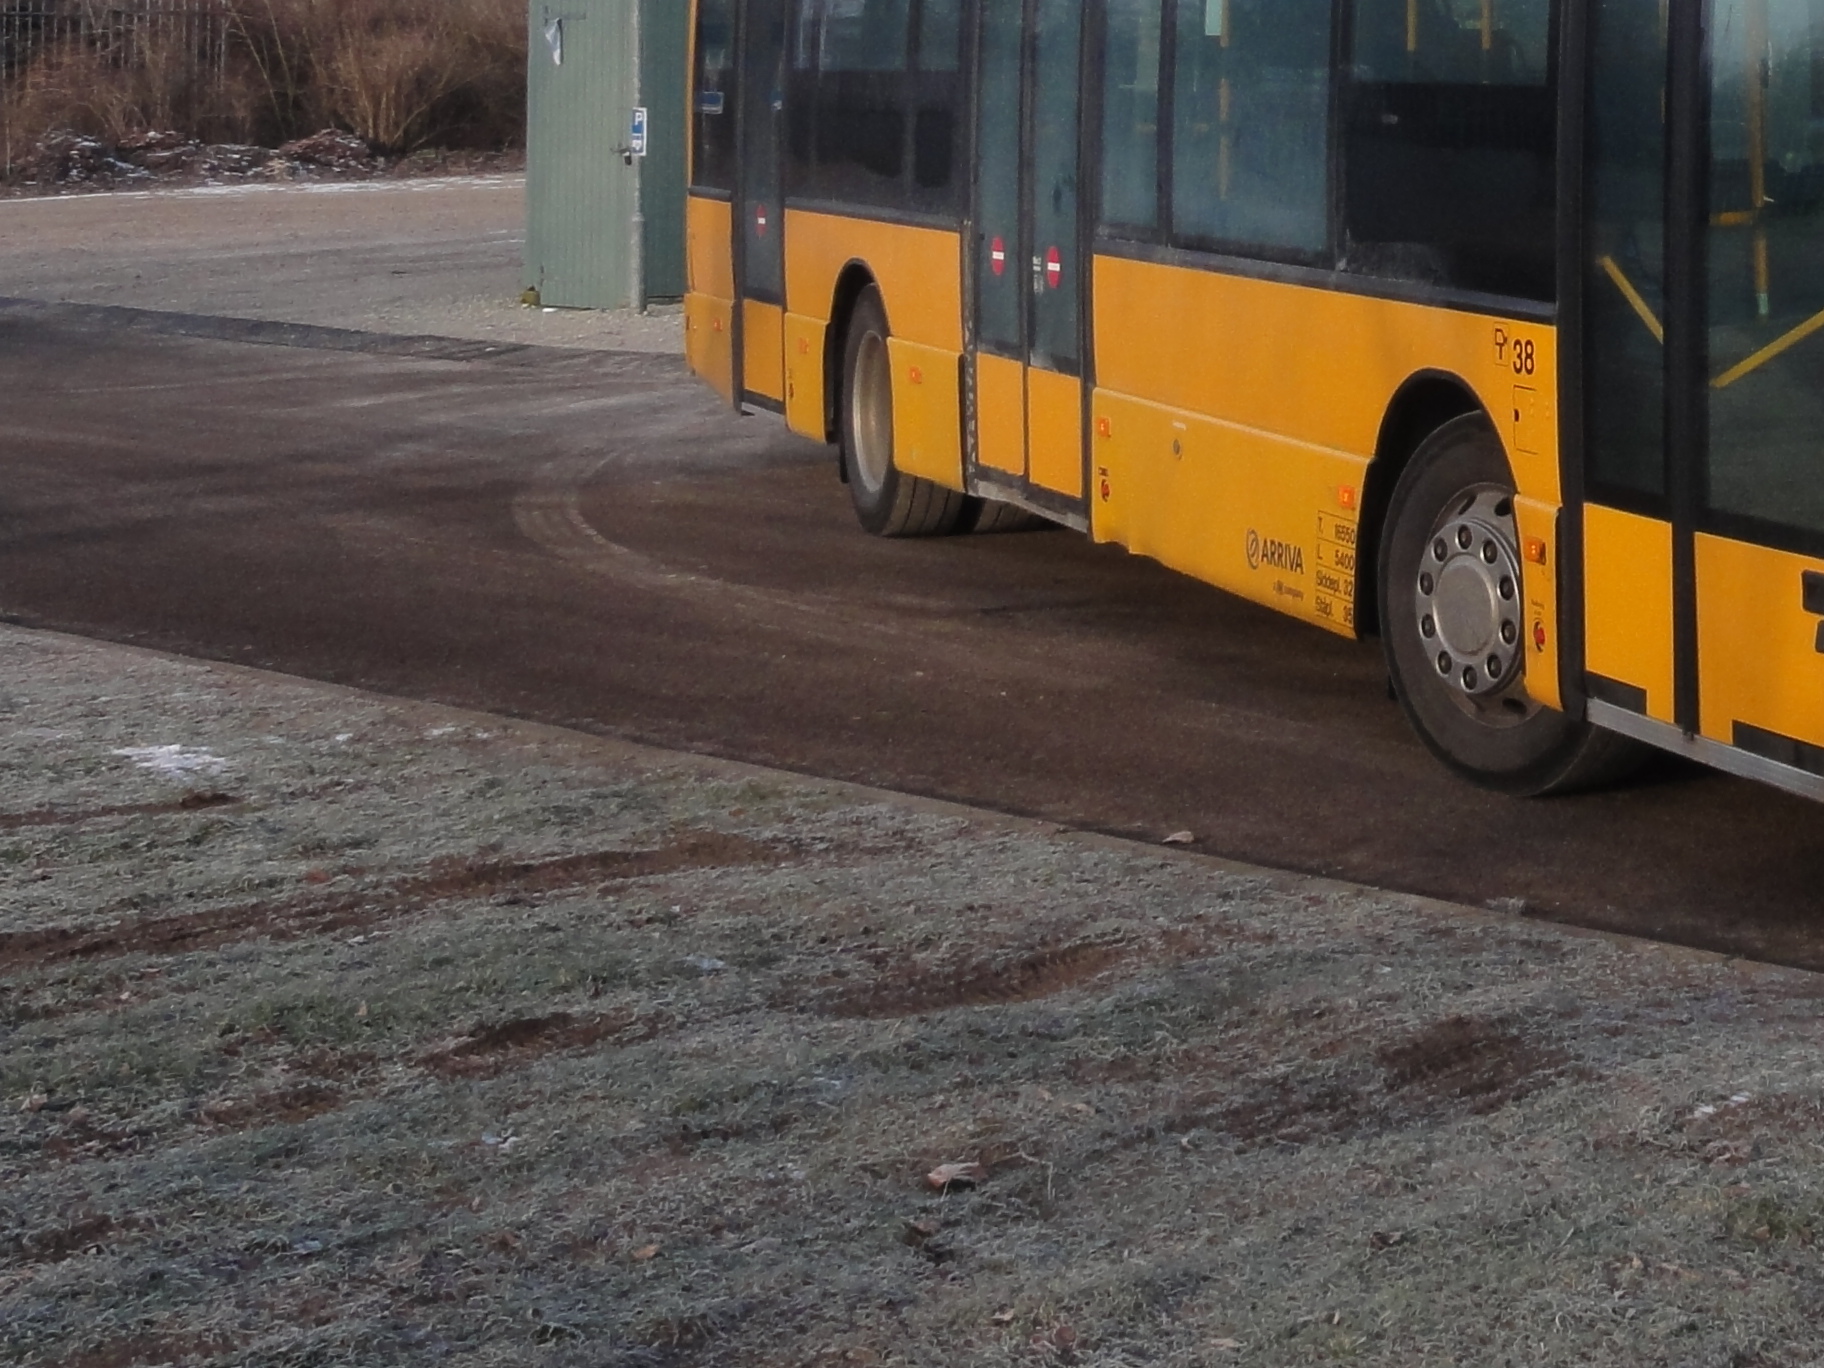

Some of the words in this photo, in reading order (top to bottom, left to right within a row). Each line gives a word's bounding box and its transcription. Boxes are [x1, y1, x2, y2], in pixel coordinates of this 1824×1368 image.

[635, 112, 643, 125] P
[1513, 339, 1535, 375] 38
[1261, 537, 1304, 575] ARRIVA
[1334, 549, 1355, 571] 5400
